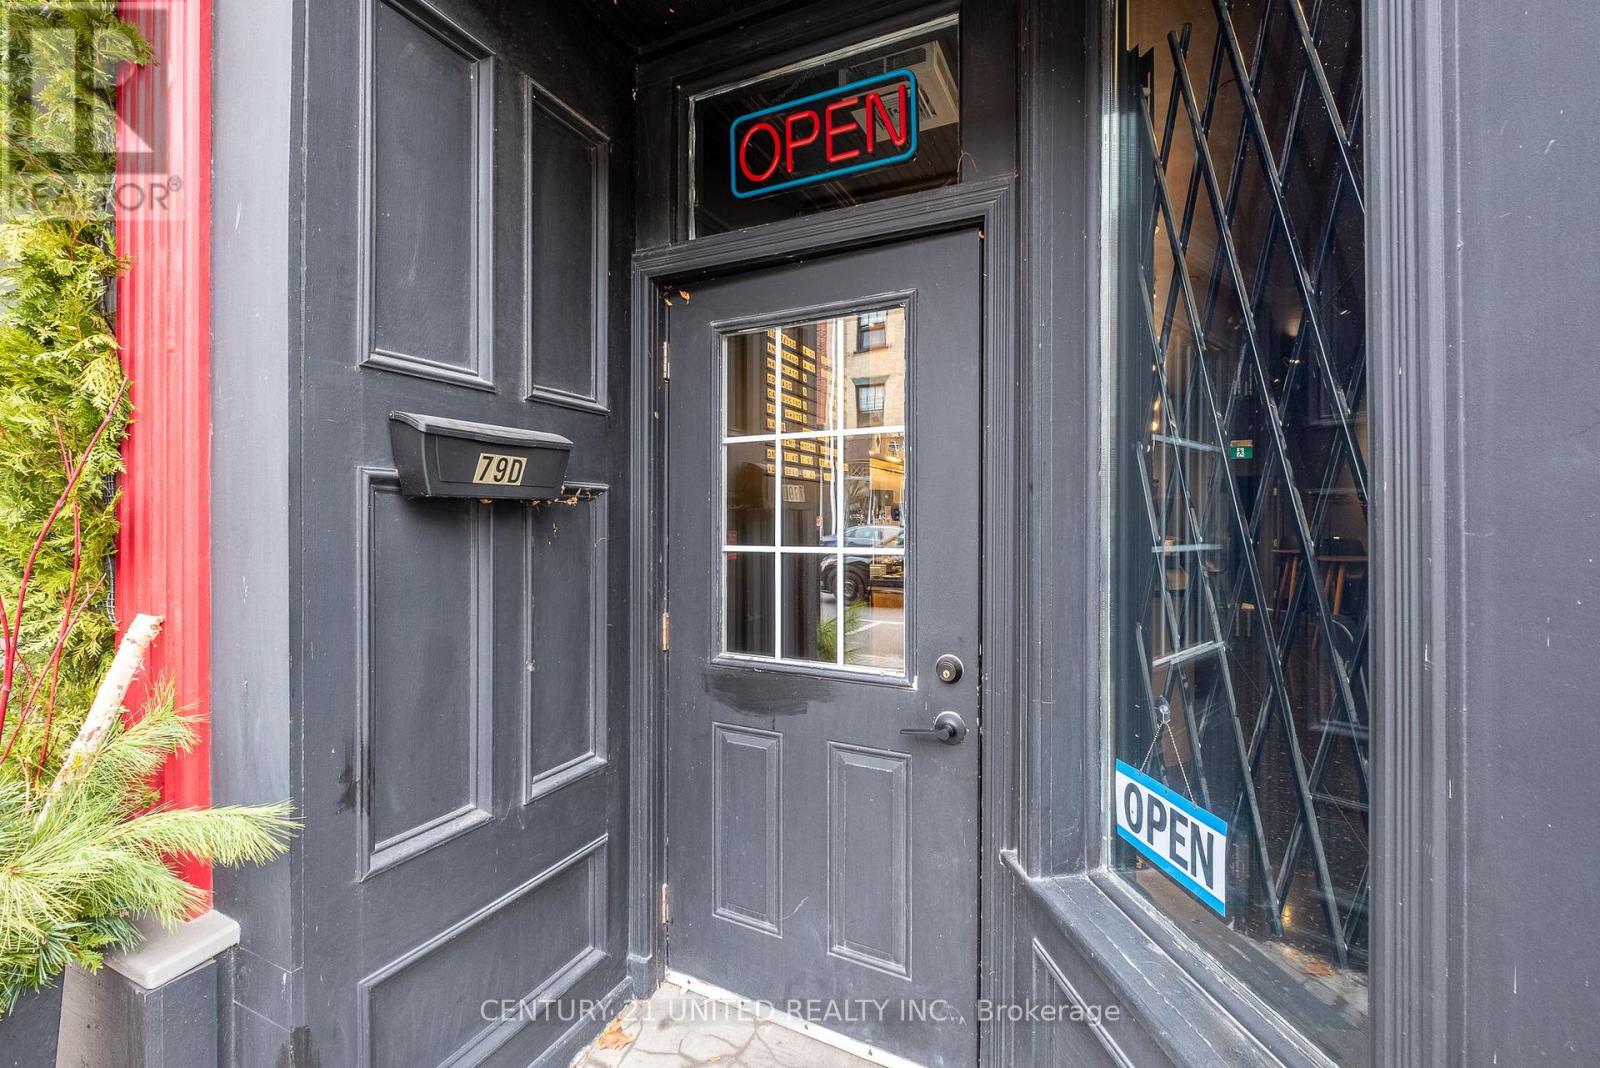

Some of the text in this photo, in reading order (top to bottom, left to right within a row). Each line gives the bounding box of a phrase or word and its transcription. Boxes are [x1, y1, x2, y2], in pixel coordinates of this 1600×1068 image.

[739, 84, 907, 182] OPEN
[479, 456, 523, 483] 79D
[1124, 783, 1214, 890] OPEN
